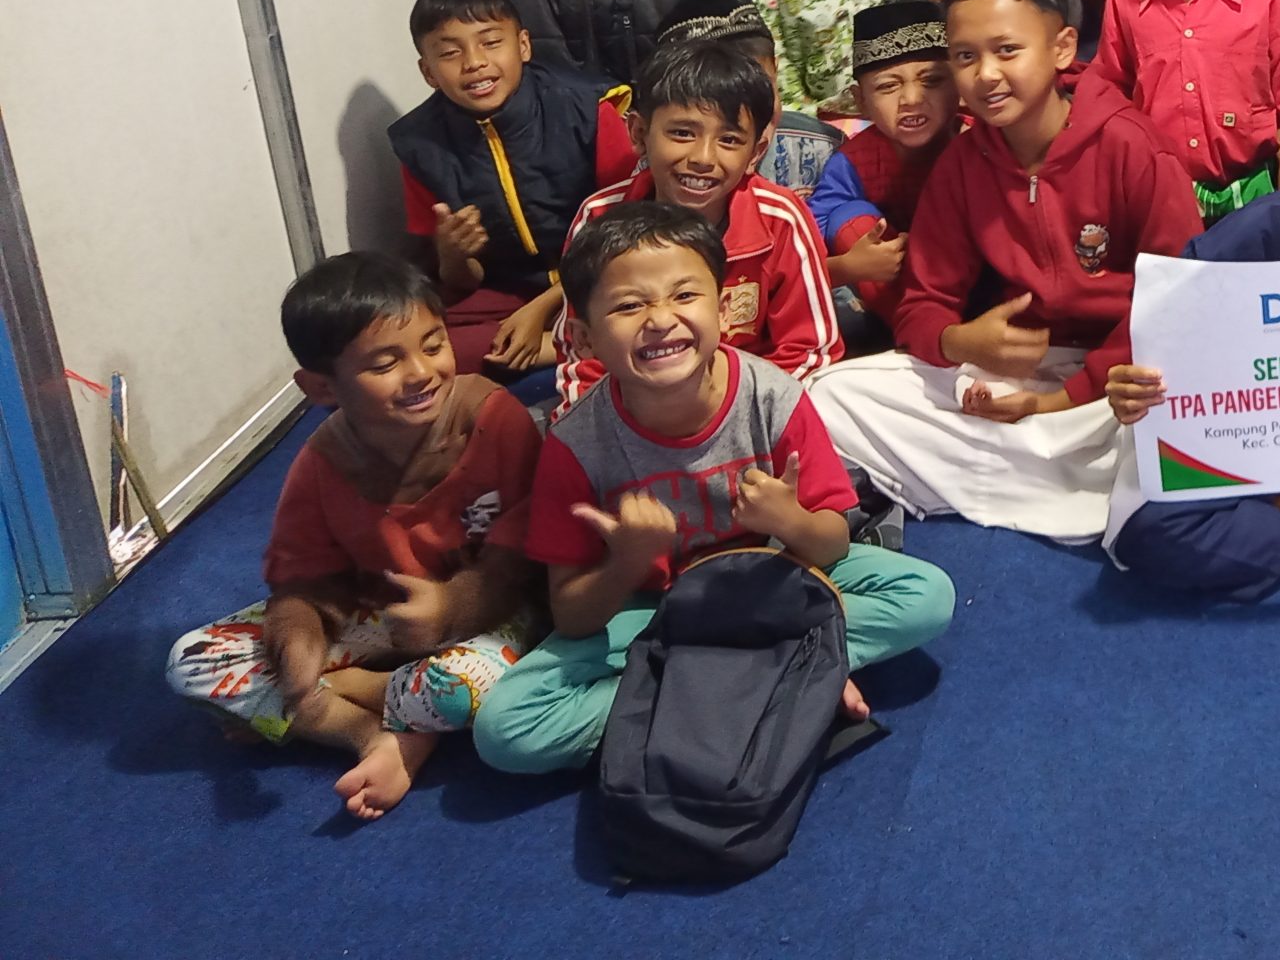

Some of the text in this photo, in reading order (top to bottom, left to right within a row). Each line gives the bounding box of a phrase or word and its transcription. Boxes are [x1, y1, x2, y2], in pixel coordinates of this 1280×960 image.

[1166, 393, 1207, 420] TPA
[1204, 423, 1268, 439] Kampung
[1242, 438, 1269, 450] Kec.
